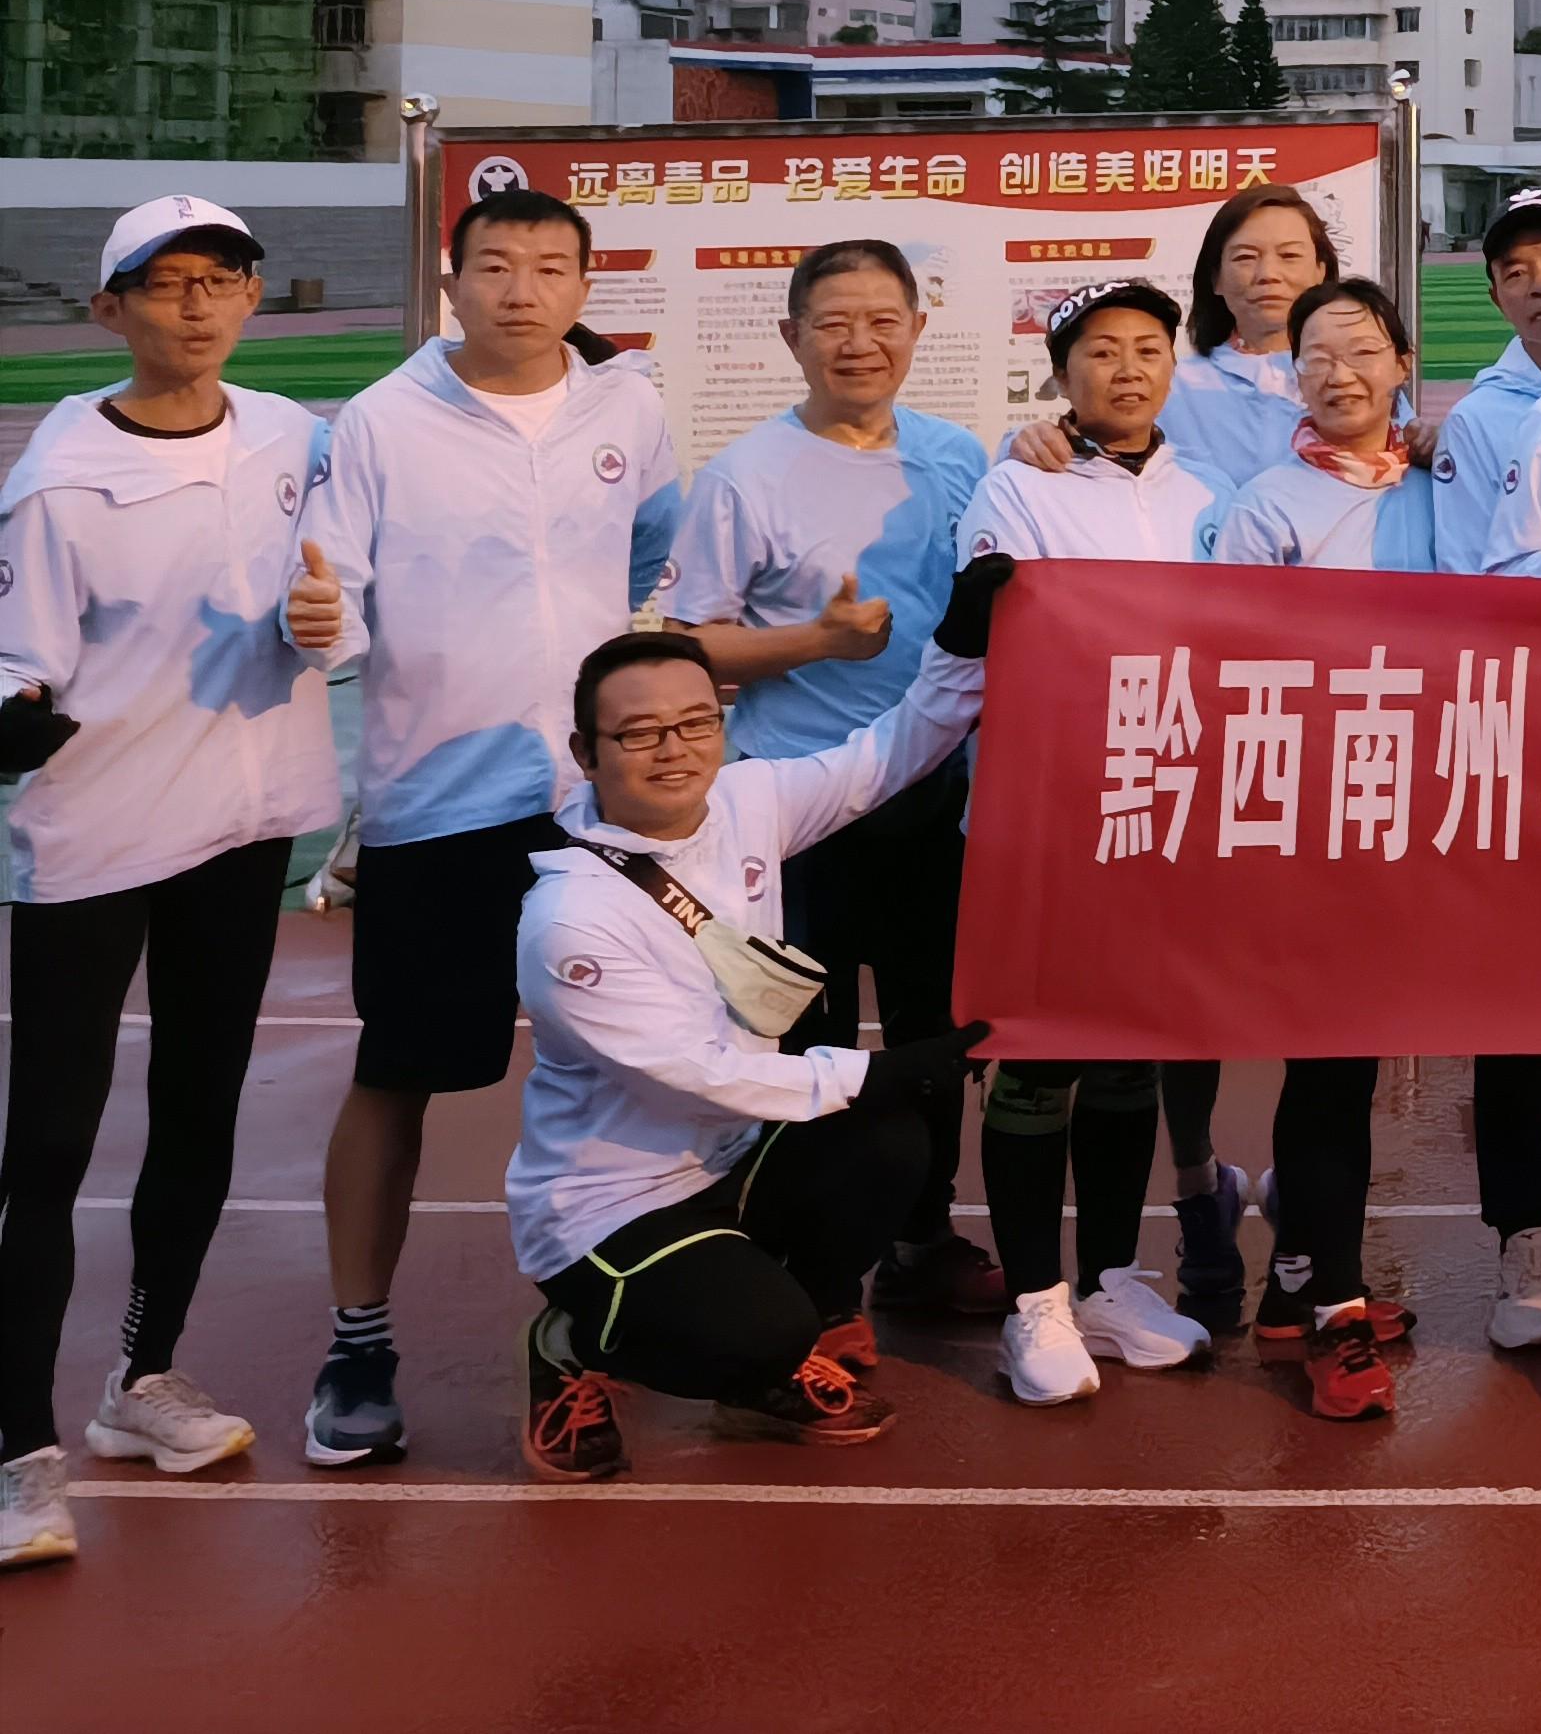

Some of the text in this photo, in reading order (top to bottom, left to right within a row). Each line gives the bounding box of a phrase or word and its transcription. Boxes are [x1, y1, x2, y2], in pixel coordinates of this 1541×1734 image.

[567, 147, 1277, 206] 远离毒品 珍爱生命 创造美好明天
